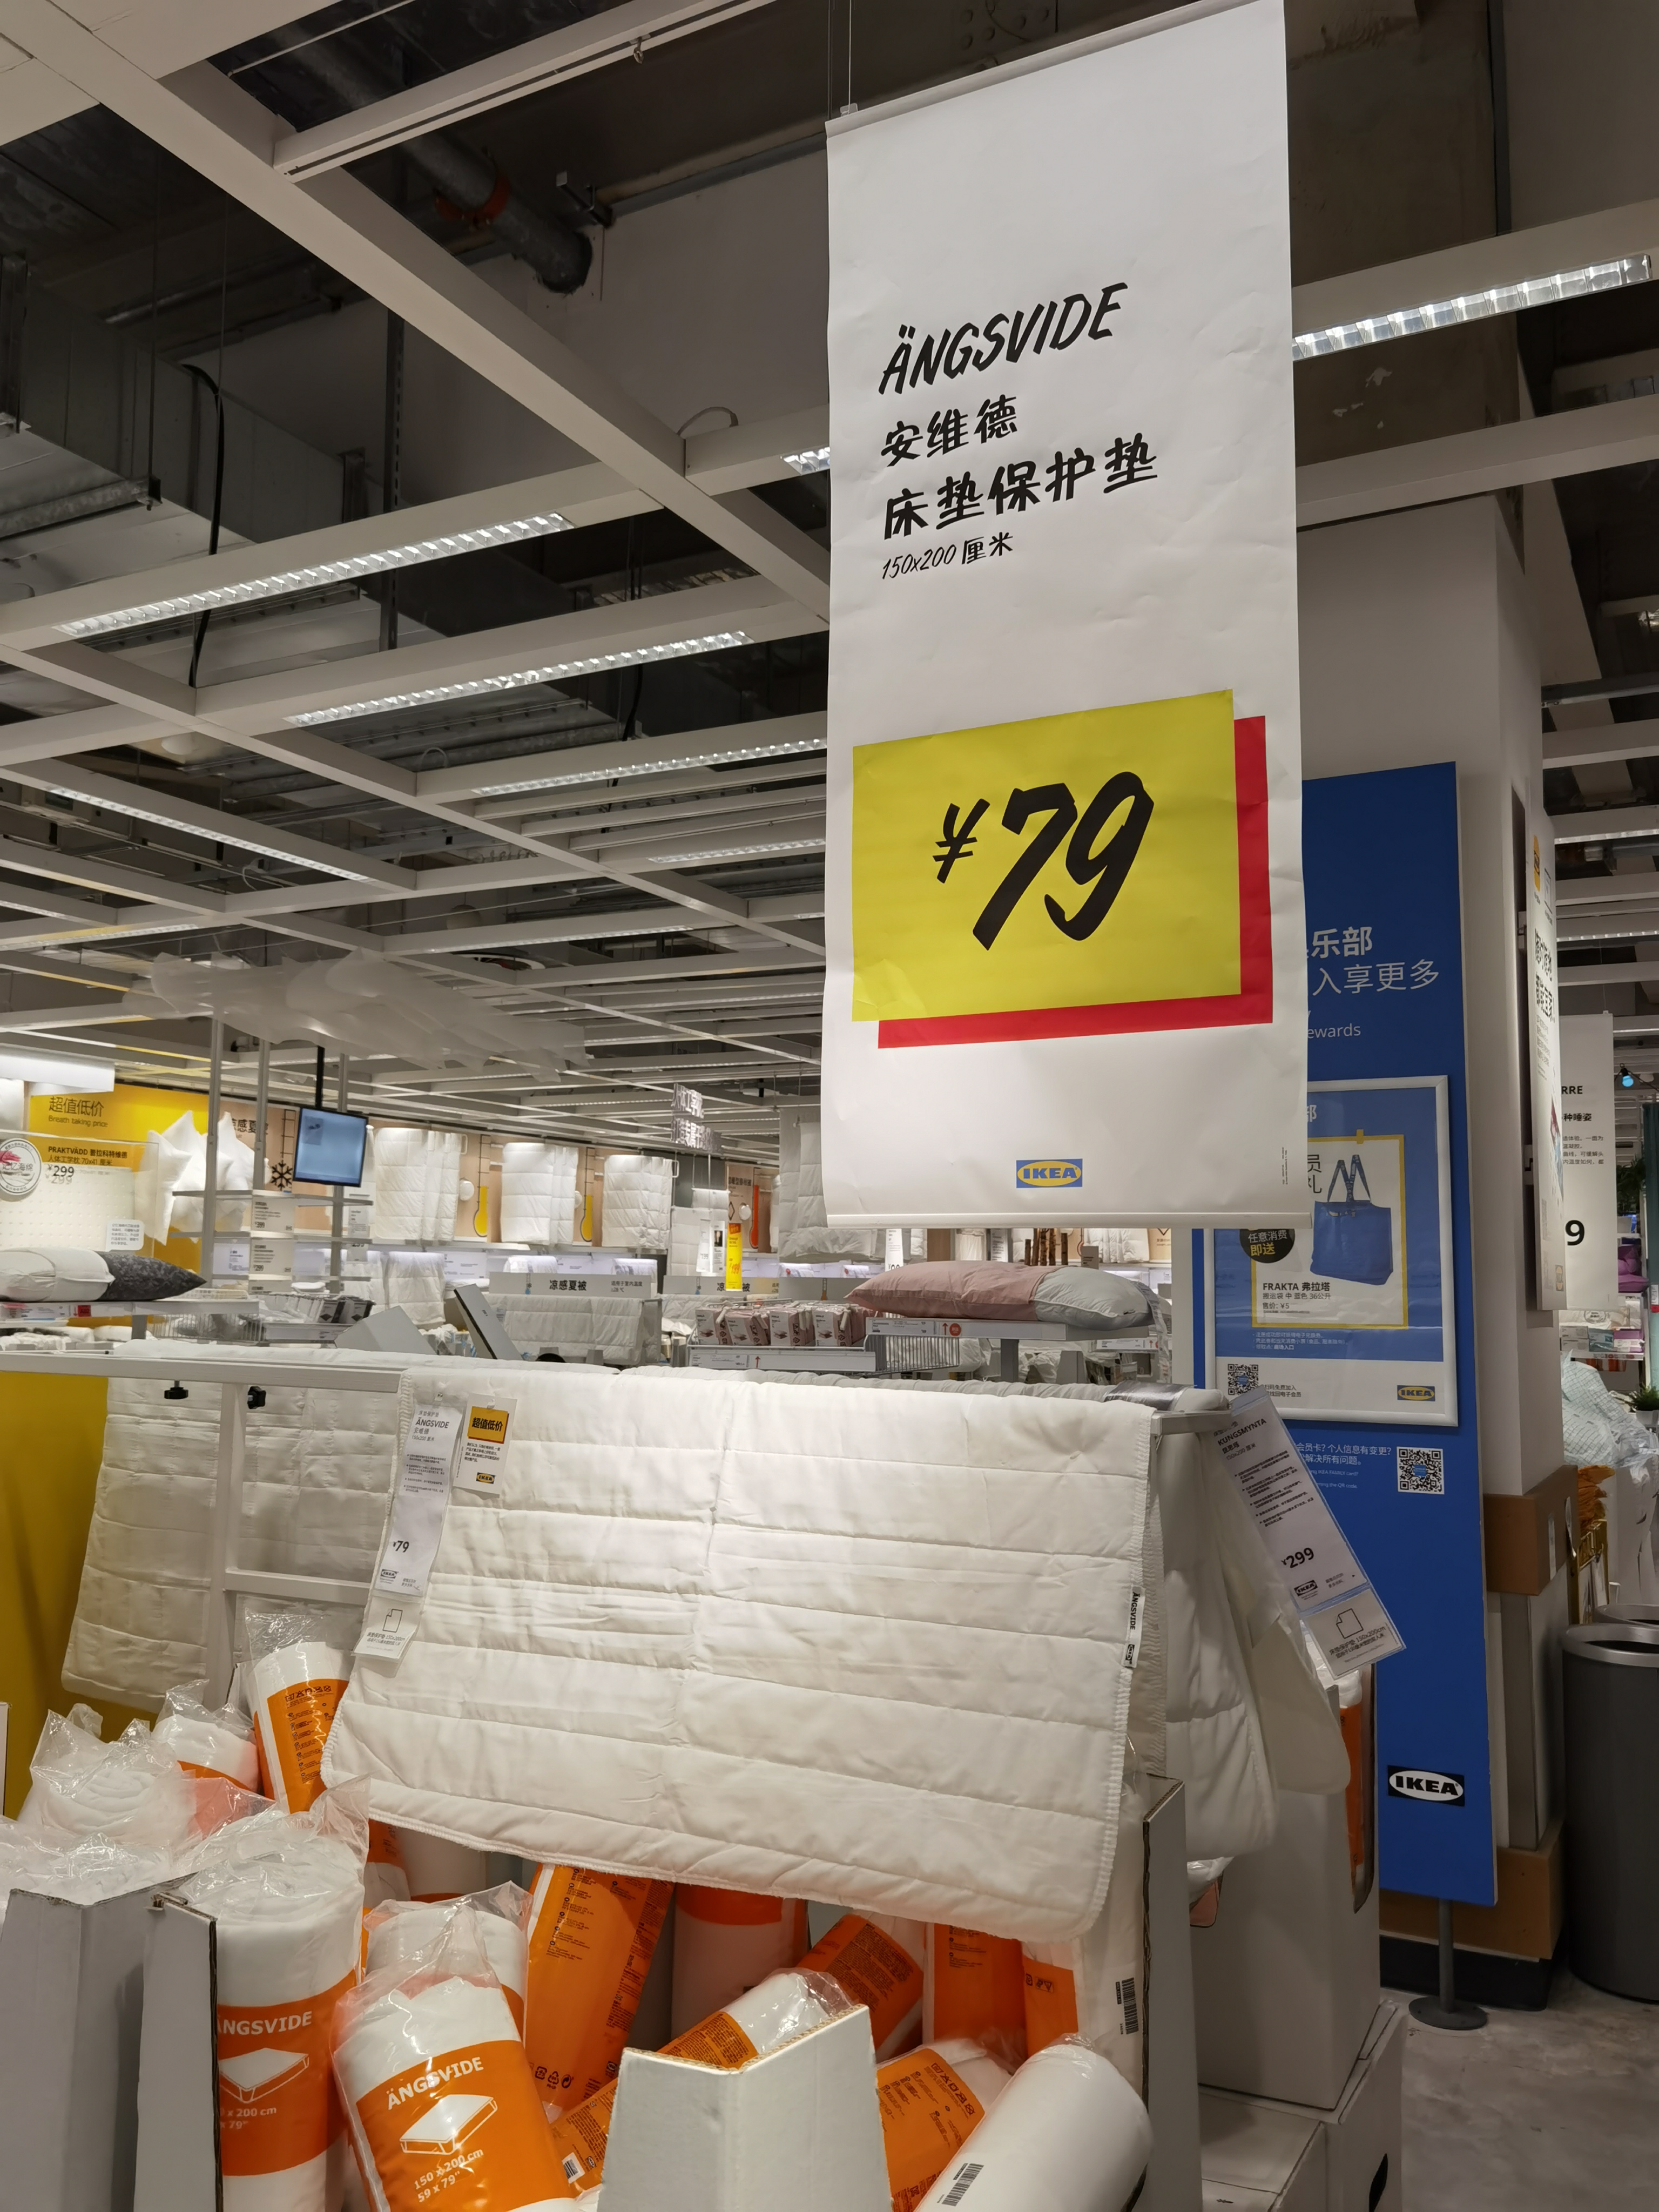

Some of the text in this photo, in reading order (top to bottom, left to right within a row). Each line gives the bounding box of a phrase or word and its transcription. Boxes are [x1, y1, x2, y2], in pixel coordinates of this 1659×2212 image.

[878, 282, 1128, 394] ÄNGSVIDE
[881, 394, 1017, 467] 安维德
[884, 433, 1158, 540] 床垫保护垫
[882, 532, 1014, 579] 150x200 厘米
[1307, 926, 1373, 959] 乐部
[1312, 959, 1439, 996] 入享更多
[1307, 1023, 1361, 1039] ewards
[49, 1096, 104, 1117] 超值低价
[49, 1115, 69, 1124] Breath
[72, 1116, 91, 1127] taking
[1562, 1113, 1592, 1122] 种睡姿
[1022, 1167, 1077, 1179] IKEA
[1248, 1229, 1288, 1244] 任意消费
[1250, 1242, 1276, 1257] 即送
[549, 1279, 587, 1291] 凉感夏被
[1263, 1282, 1331, 1292] FRAKTA 弗拉塔
[415, 1417, 450, 1429] ÄNGSVIDE
[471, 1417, 503, 1432] 超值低价
[1217, 1418, 1267, 1446] KUNGSMYNTA
[1297, 1582, 1315, 1593] IKEA
[1130, 1591, 1141, 1630] ÄNGSVIDE
[1395, 1775, 1459, 1796] IKEA
[386, 2056, 484, 2110] ÄNGSVIDE
[237, 2107, 258, 2117] 200
[260, 2107, 277, 2115] cm
[414, 2171, 434, 2190] 150
[444, 2154, 466, 2173] 200
[467, 2149, 484, 2162] cm
[417, 2189, 431, 2203] 59
[433, 2183, 441, 2193] x
